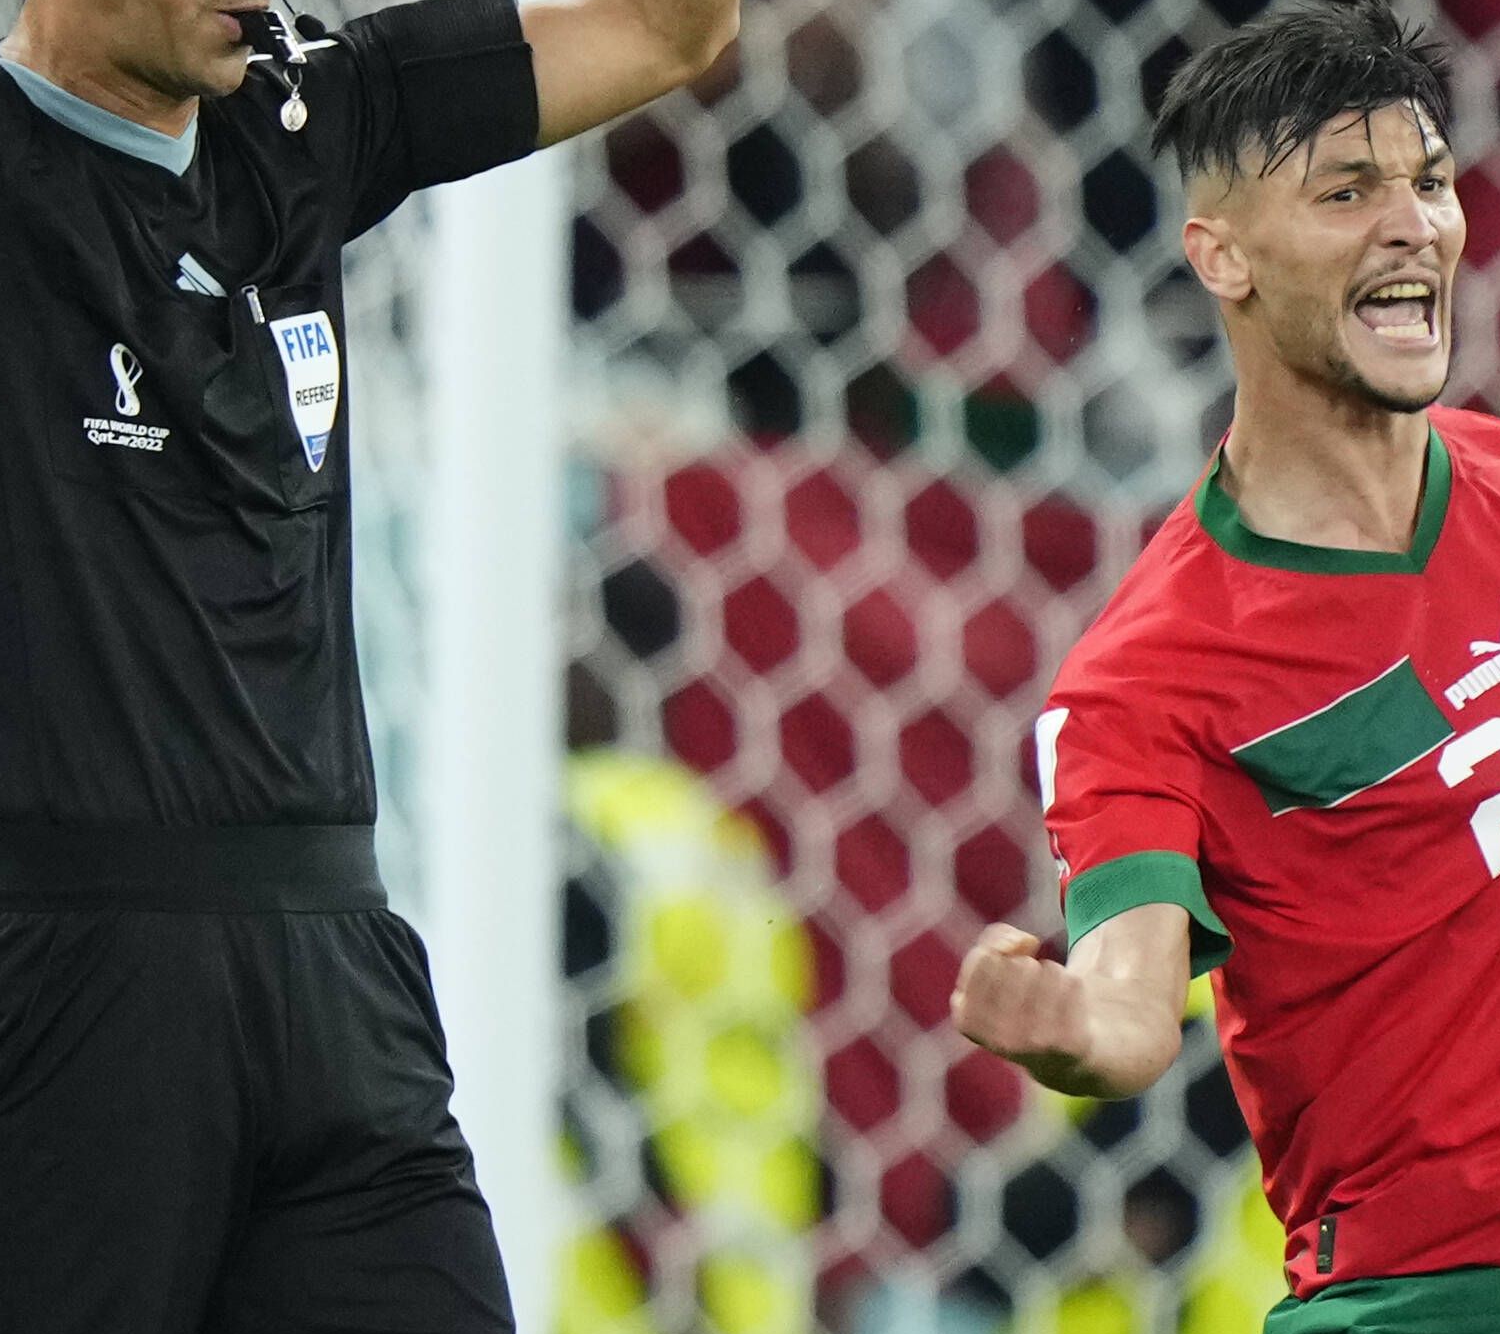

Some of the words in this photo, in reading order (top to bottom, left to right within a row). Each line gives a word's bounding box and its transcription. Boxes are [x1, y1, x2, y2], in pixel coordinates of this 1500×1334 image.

[281, 322, 332, 363] FIFA
[295, 381, 336, 408] REFEREE
[83, 418, 110, 430] FIFA
[110, 420, 148, 436] WORLD
[148, 427, 170, 439] CUP
